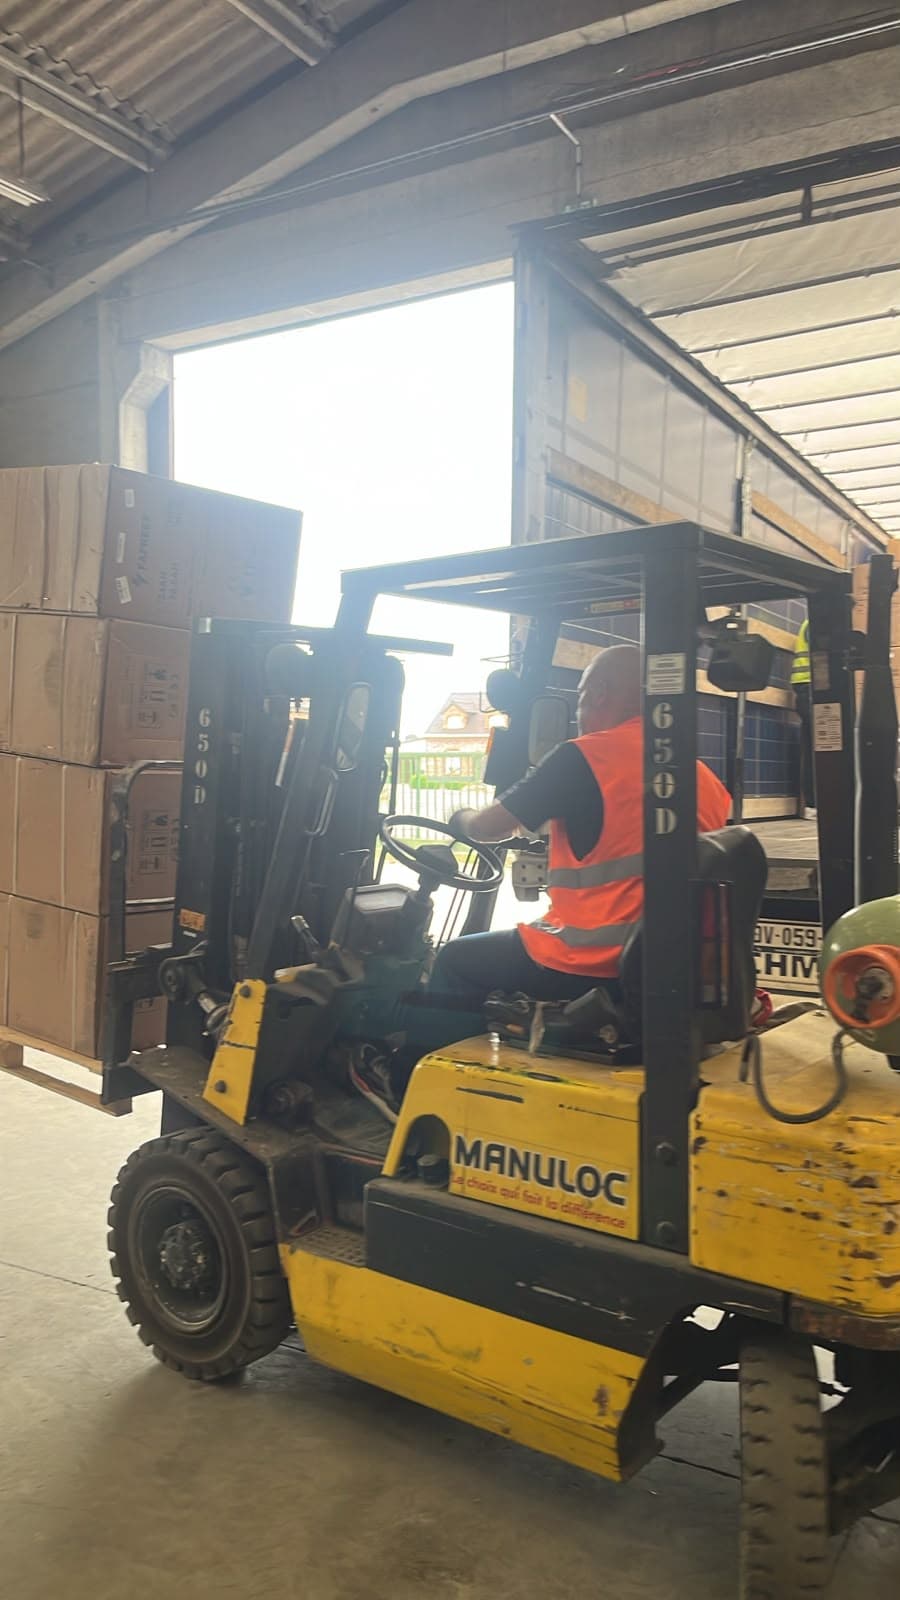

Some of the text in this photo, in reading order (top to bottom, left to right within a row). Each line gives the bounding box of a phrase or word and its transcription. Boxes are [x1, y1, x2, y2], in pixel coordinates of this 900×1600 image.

[194, 708, 211, 804] 650D
[652, 703, 677, 835] 650D
[455, 1135, 627, 1206] MANULOC
[467, 1176, 498, 1194] choix
[500, 1184, 520, 1200] qui
[523, 1190, 544, 1206] fait
[546, 1195, 558, 1210] la
